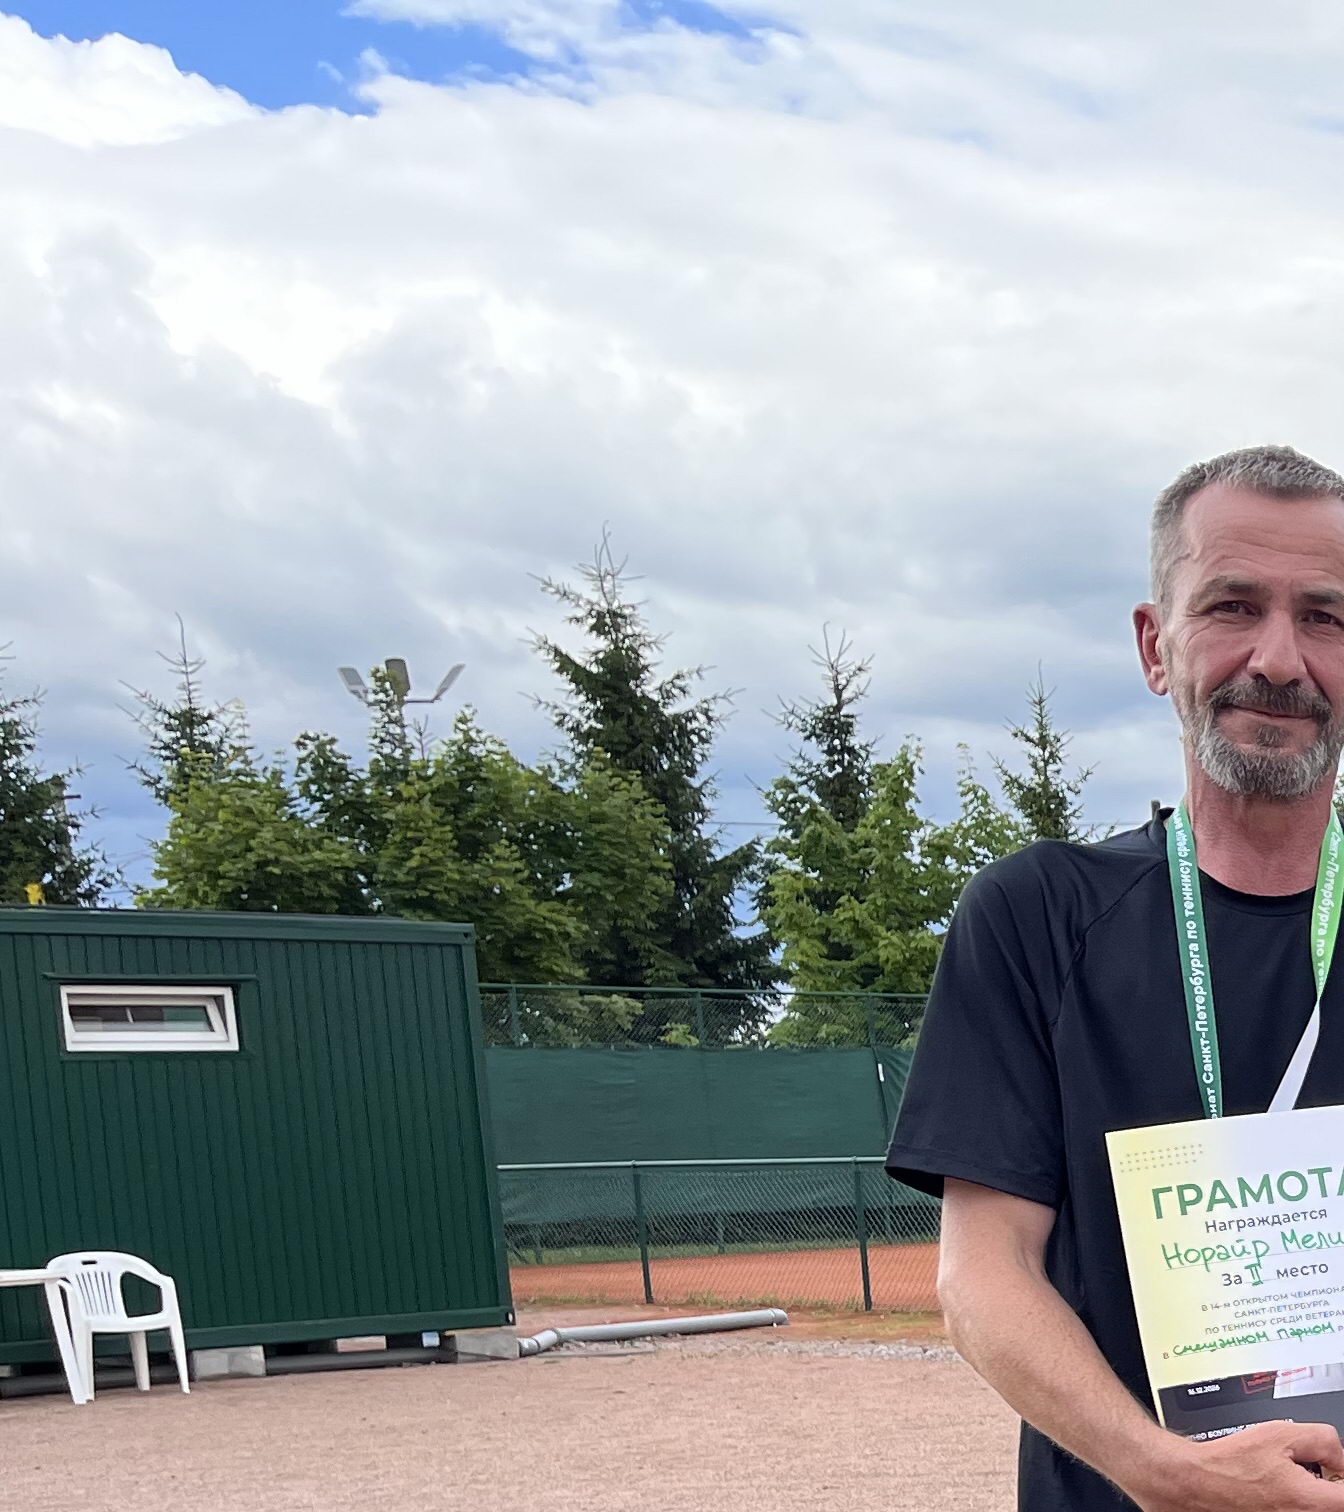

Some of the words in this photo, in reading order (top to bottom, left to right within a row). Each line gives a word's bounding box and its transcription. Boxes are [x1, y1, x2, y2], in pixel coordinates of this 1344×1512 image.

[1179, 859, 1196, 917] теннису
[1186, 920, 1198, 939] по
[1316, 939, 1326, 956] по
[1205, 1207, 1327, 1234] Награждается
[1161, 1240, 1271, 1271] Норайр
[1222, 1272, 1243, 1287] За
[1276, 1261, 1329, 1279] место
[1232, 1293, 1288, 1307] ОТКРЫТОМ
[1234, 1300, 1330, 1318] САНКТ-ПЕТЕРБУРГА
[1205, 1326, 1219, 1334] ПО
[1222, 1319, 1267, 1332] ТЕННИСУ
[1270, 1314, 1303, 1326] СРЕДИ
